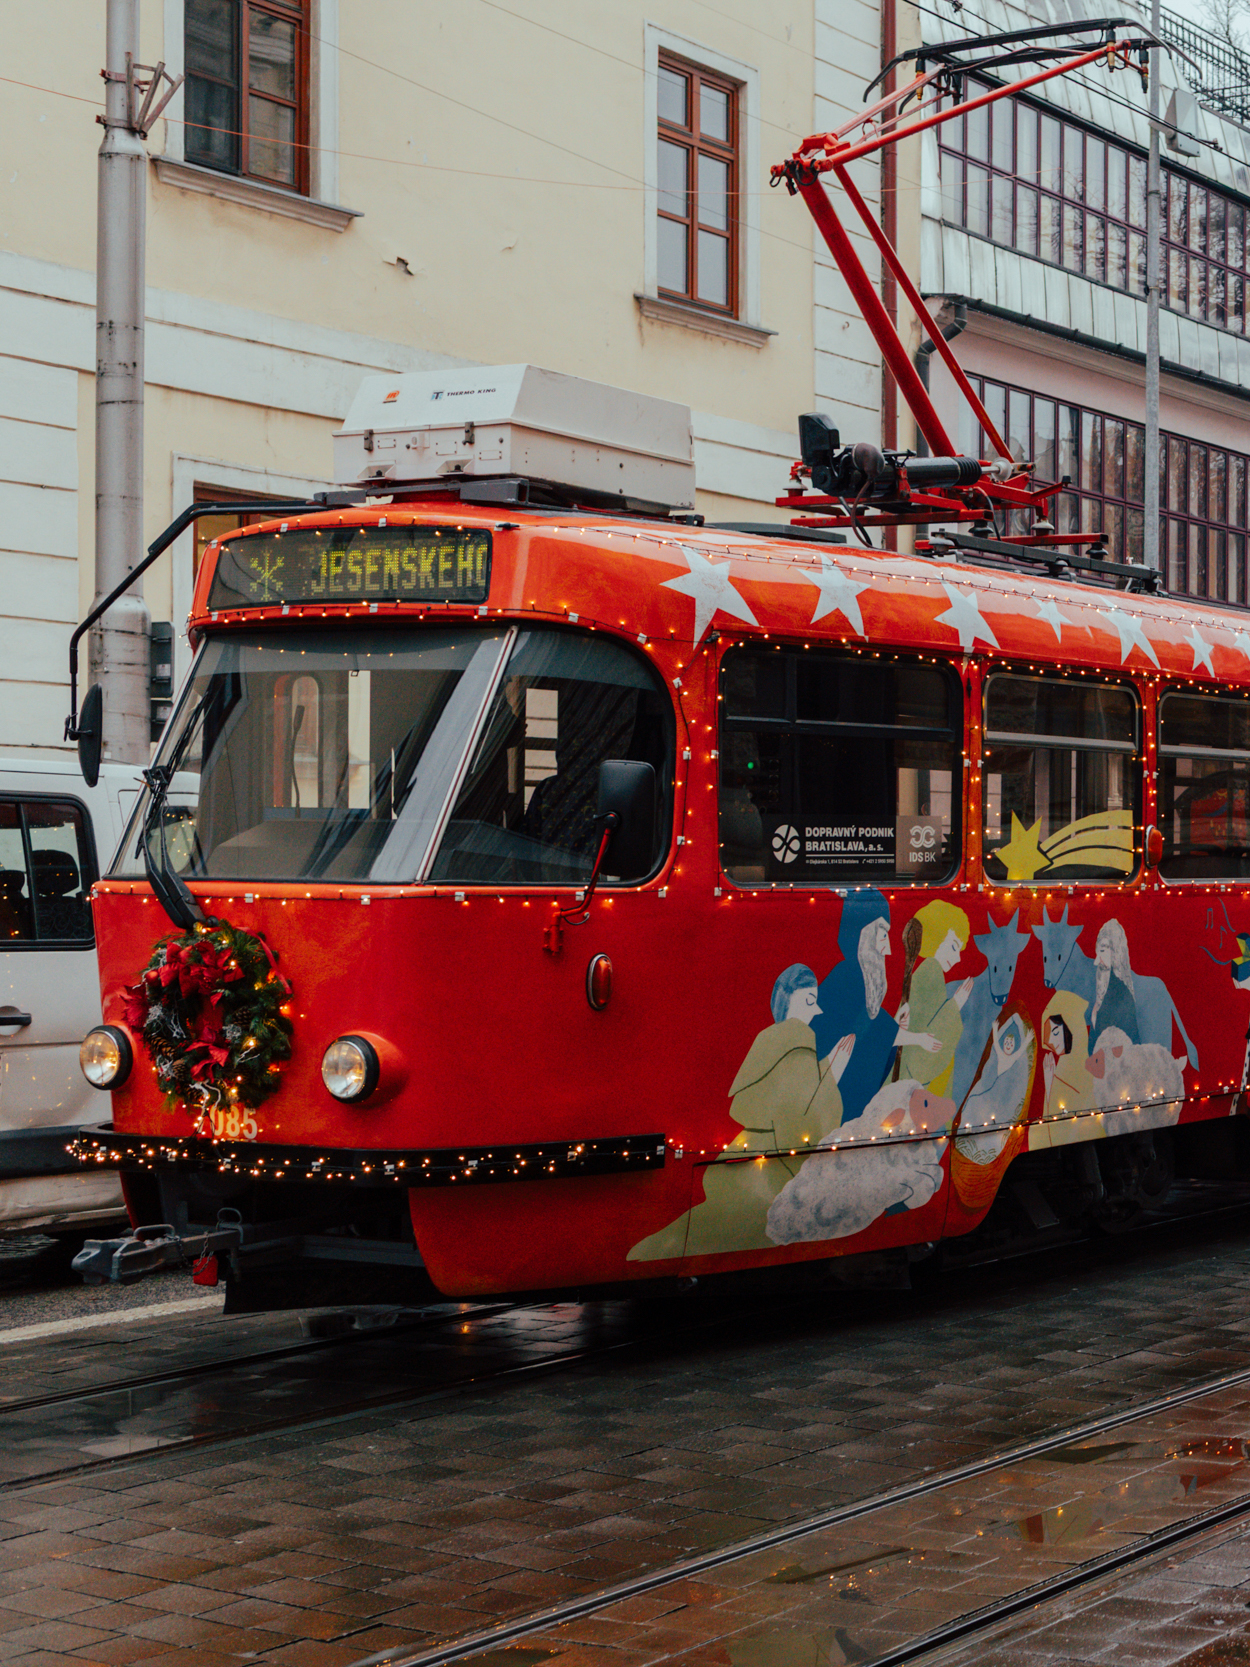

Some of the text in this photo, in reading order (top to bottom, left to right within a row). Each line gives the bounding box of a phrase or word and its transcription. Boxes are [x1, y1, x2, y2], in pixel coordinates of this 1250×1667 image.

[446, 389, 475, 397] THERMO
[805, 825, 894, 837] DOPRAVNÝ PODNIK
